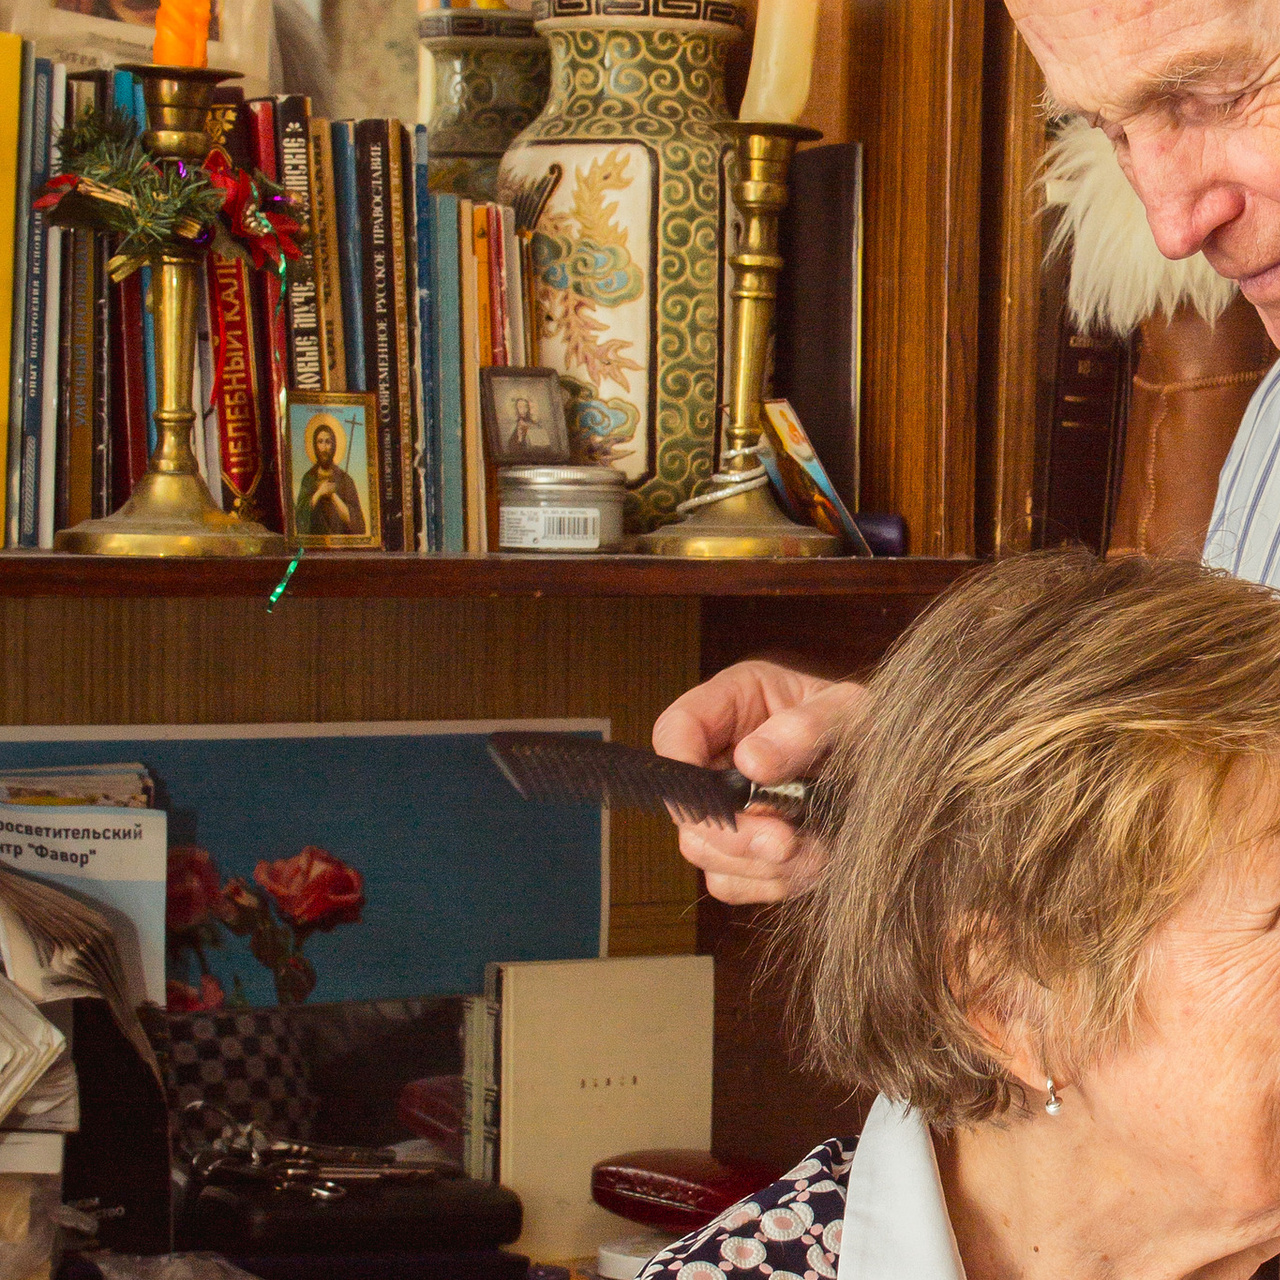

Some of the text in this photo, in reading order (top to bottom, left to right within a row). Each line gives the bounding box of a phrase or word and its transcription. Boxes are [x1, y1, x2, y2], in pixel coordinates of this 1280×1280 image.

[370, 141, 385, 245] ПРАВОСЛАВИЕ
[30, 280, 40, 358] ПОСТРОЕНИЯ
[374, 250, 387, 315] РУССКОЕ
[29, 363, 40, 398] ОПЫТ
[214, 328, 252, 474] ЦЕЛЕБНЫЙ
[376, 317, 391, 423] СОВРЕМЕННОЕ
[27, 843, 97, 868] "Фавор"
